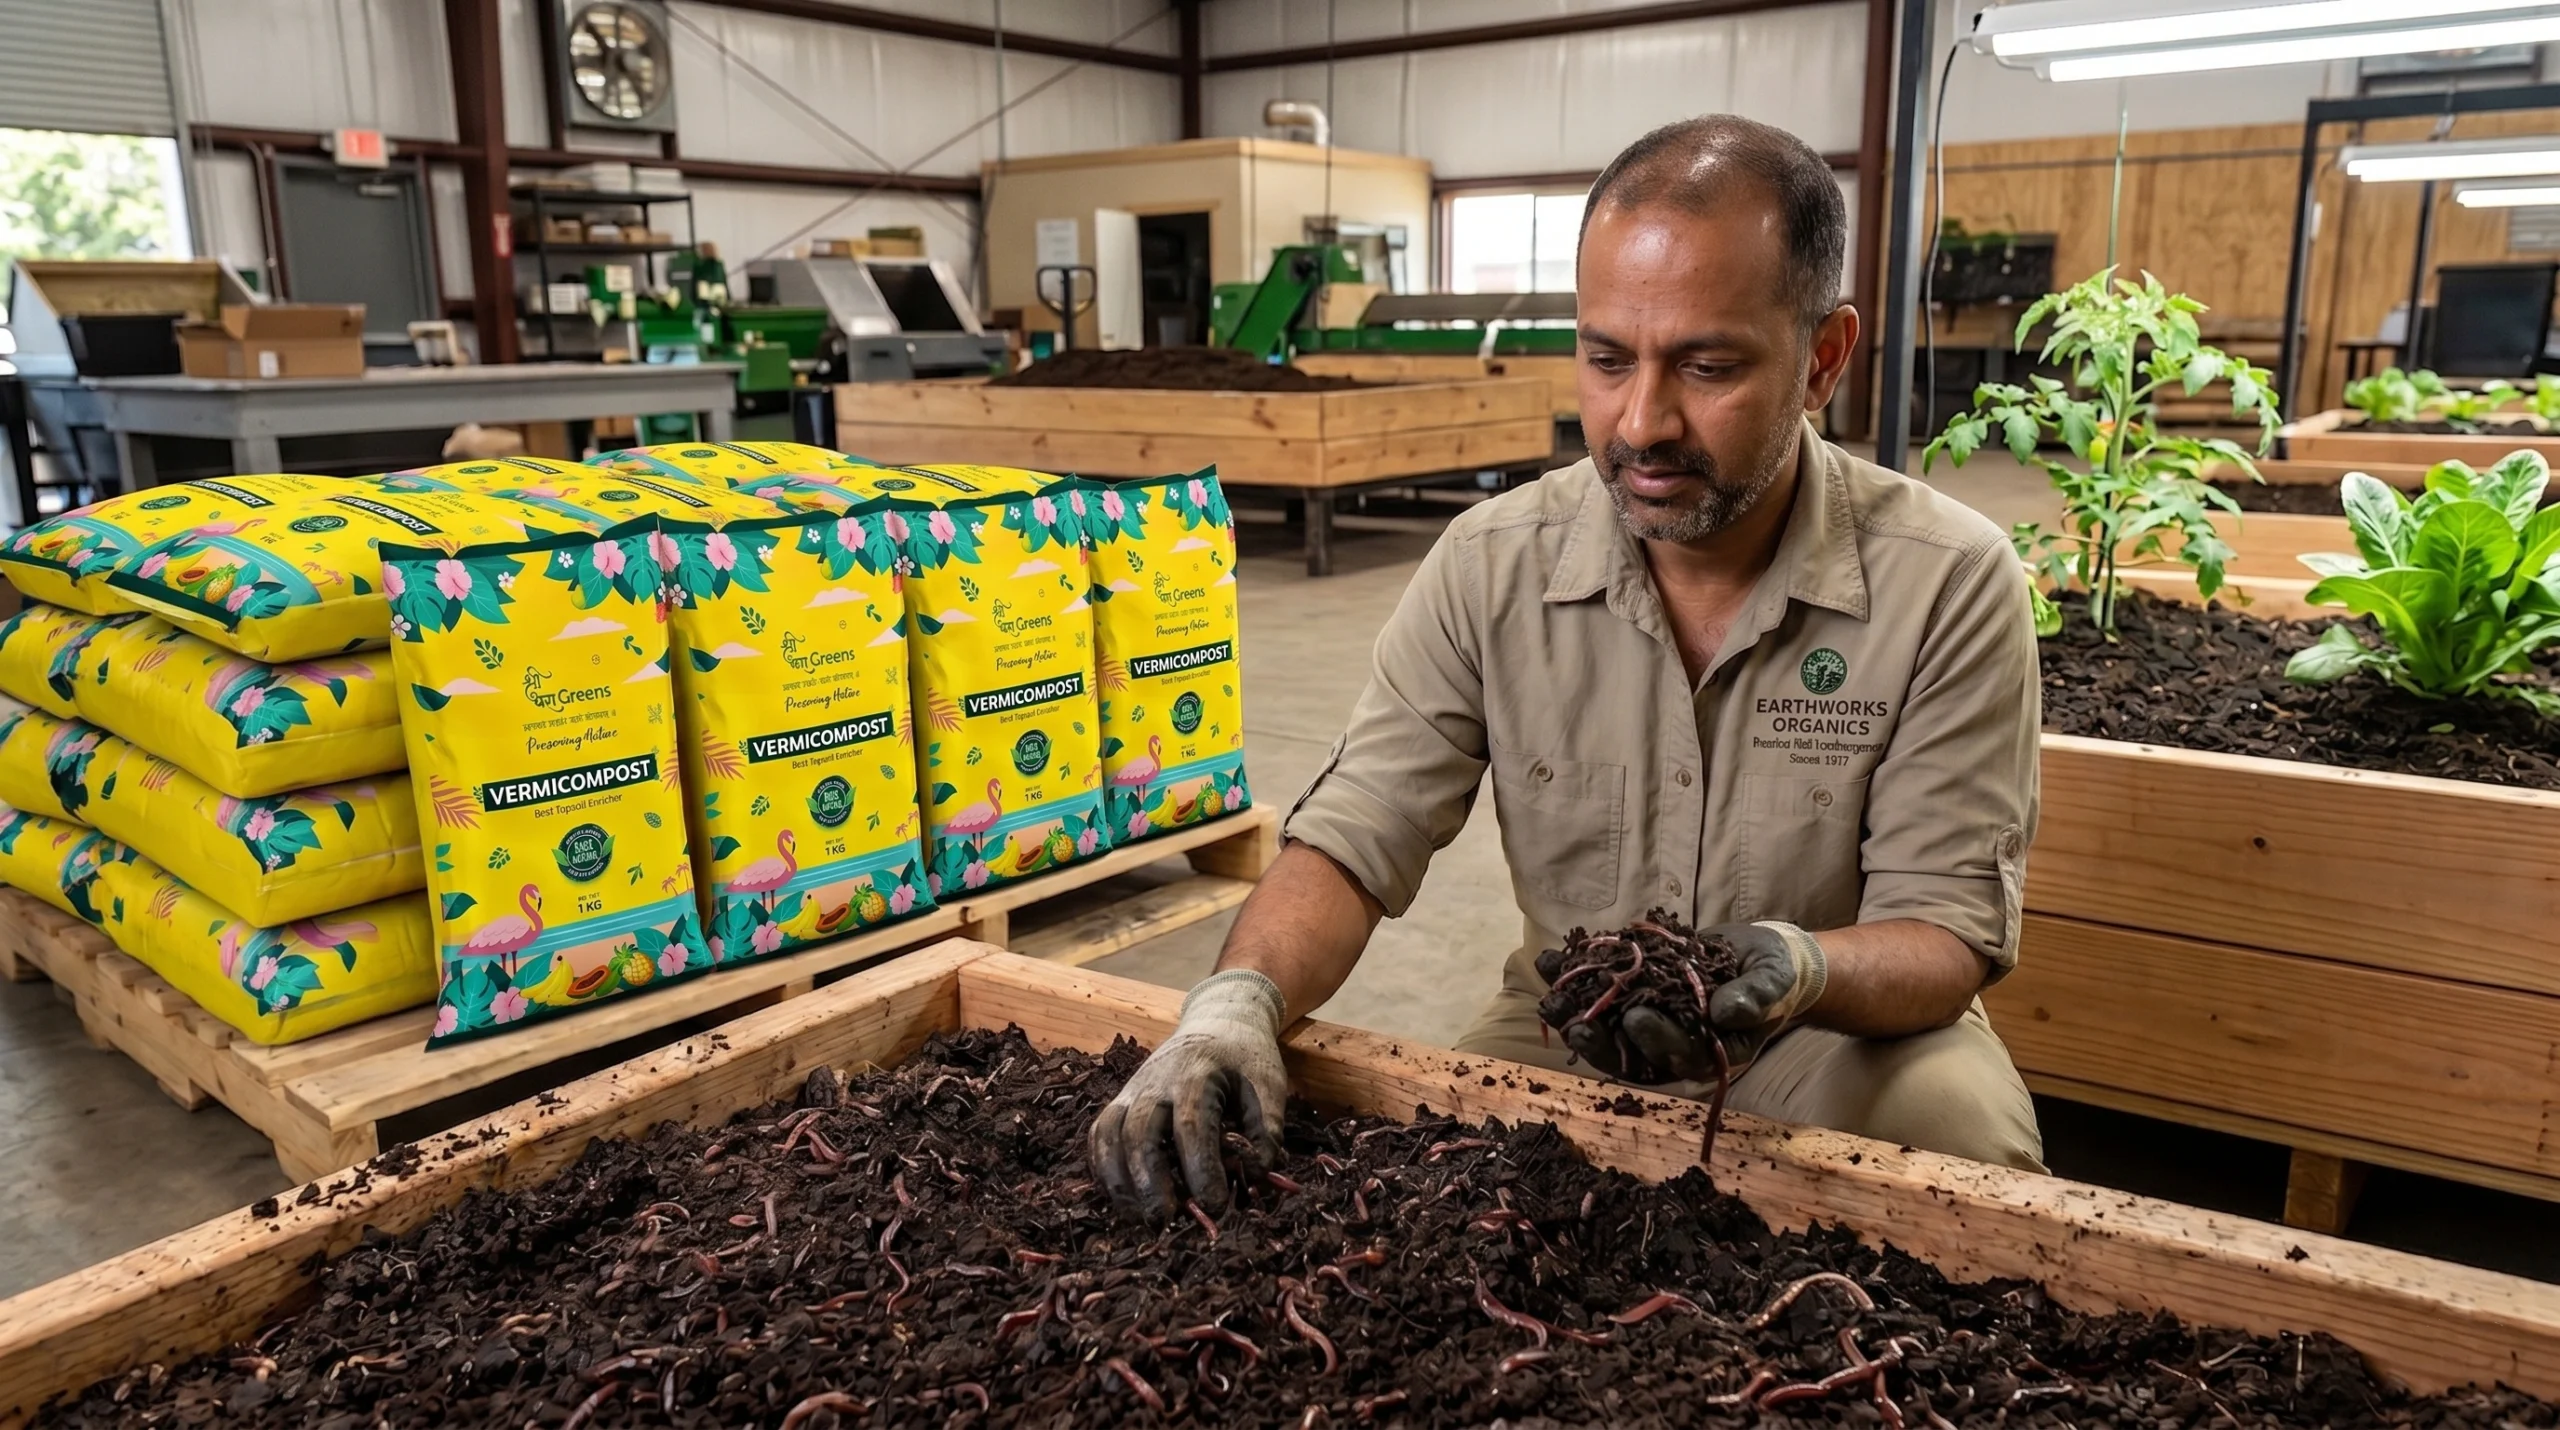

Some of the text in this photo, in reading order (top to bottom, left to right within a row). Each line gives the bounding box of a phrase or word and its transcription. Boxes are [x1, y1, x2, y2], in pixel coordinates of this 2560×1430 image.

[1173, 588, 1205, 602] Greens
[1016, 615, 1052, 631] Greens
[810, 649, 855, 666] Greens
[1134, 644, 1229, 676] VERMICOMPOST
[558, 685, 612, 705] Greens
[968, 676, 1080, 713] VERMICOMPOST
[1756, 698, 1888, 717] EARTHWORKS
[1772, 717, 1870, 735] ORGANICS
[753, 716, 888, 758] VERMICOMPOST
[1825, 755, 1850, 767] 1977
[489, 758, 651, 806] VERMICOMPOST
[534, 794, 623, 819] Best Topsoil Enricher
[825, 843, 846, 856] 1 KG
[578, 899, 602, 914] 1 KG
